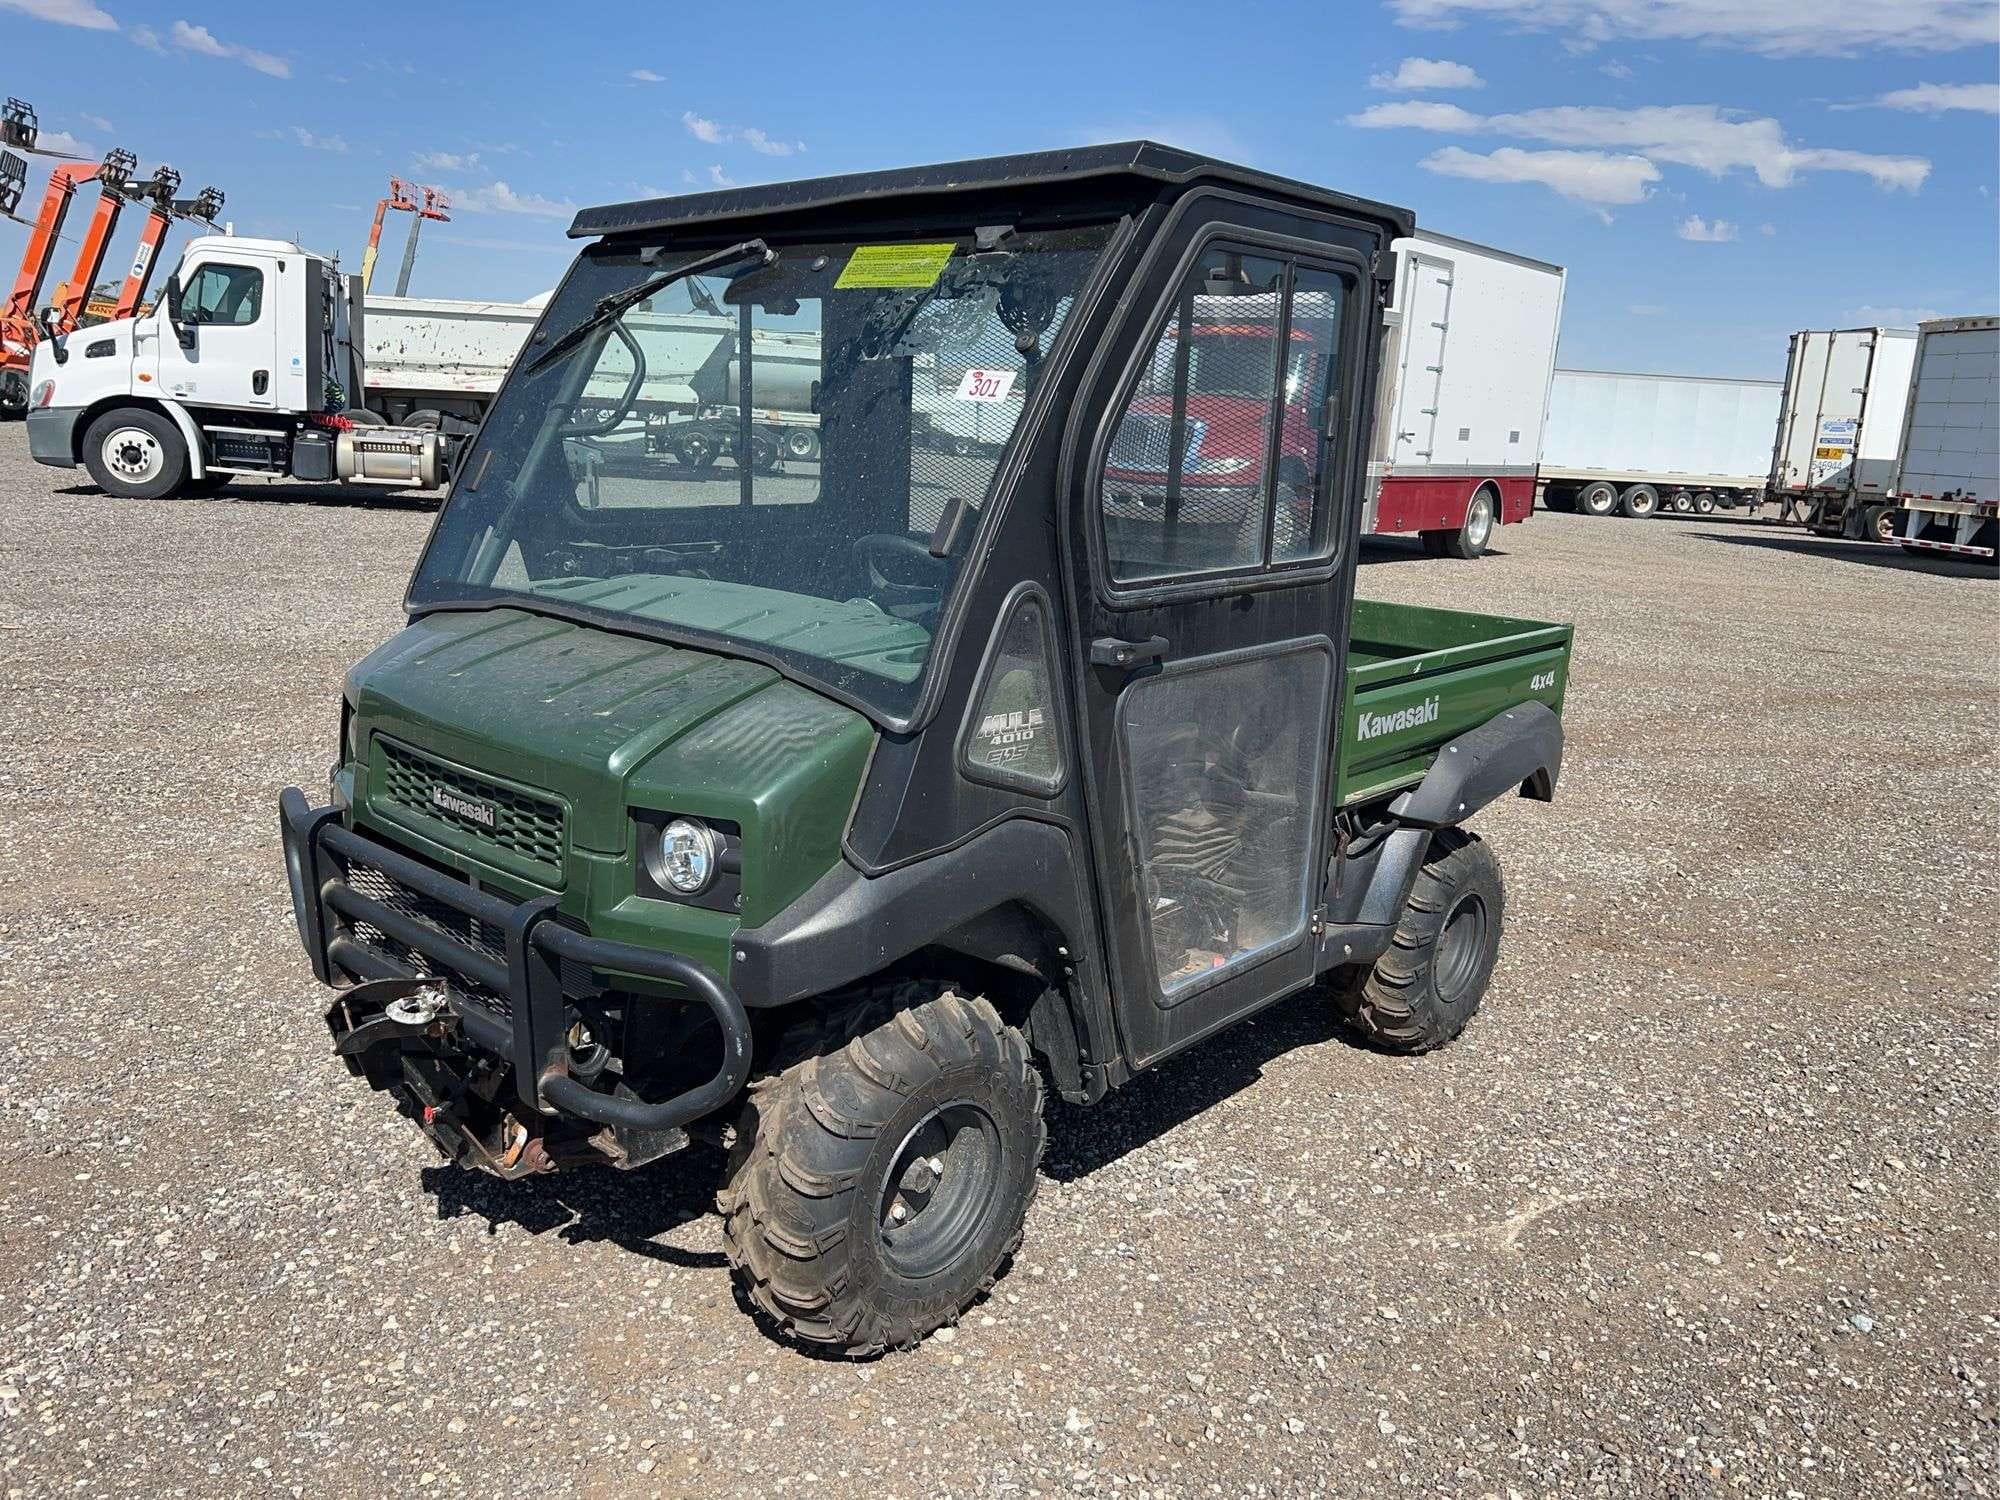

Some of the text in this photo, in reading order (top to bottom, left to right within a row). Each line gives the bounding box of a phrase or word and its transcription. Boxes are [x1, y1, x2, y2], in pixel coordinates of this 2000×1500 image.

[88, 303, 112, 315] SANY
[969, 378, 1000, 397] 301
[1530, 670, 1555, 691] 4x4
[977, 708, 1046, 738] MULE
[1357, 694, 1440, 741] Kawasaki
[990, 730, 1034, 745] 4010
[432, 785, 494, 827] Kawasaki
